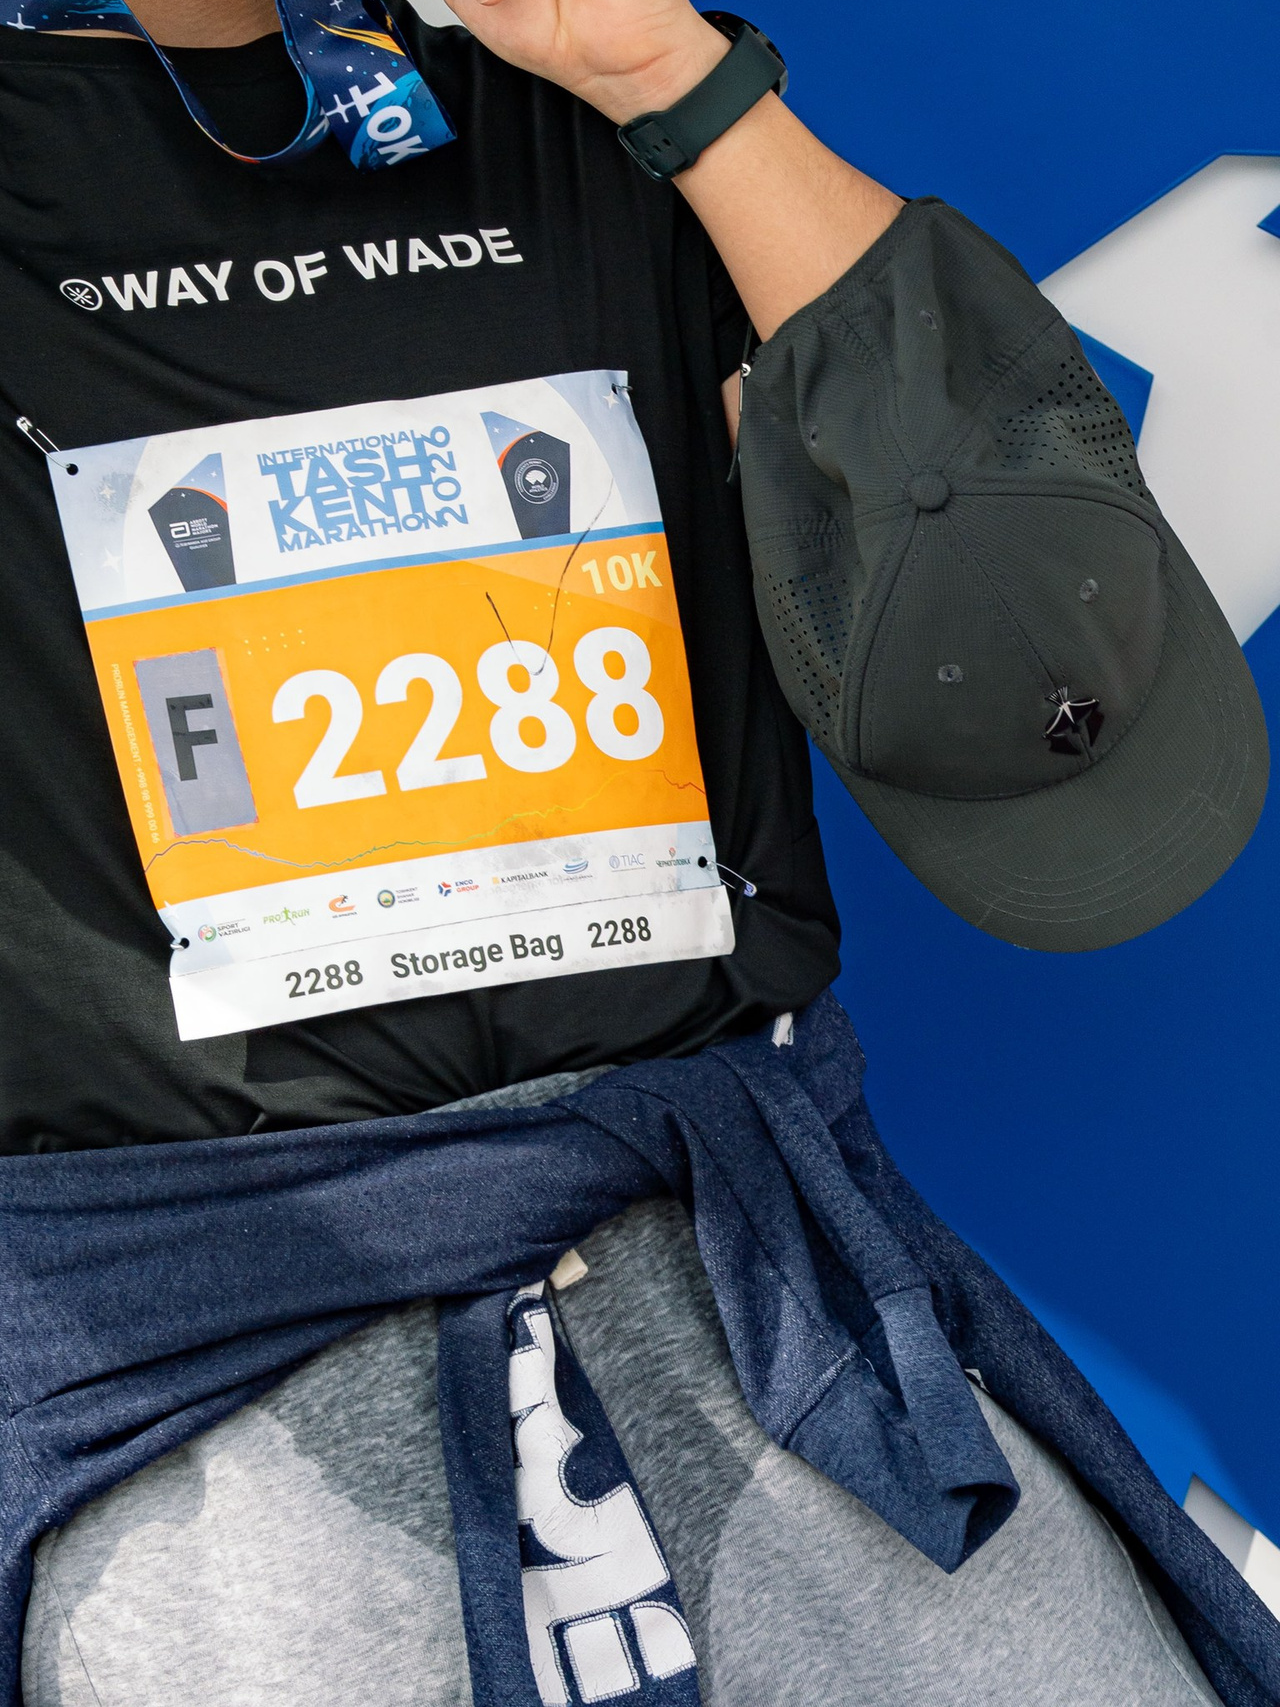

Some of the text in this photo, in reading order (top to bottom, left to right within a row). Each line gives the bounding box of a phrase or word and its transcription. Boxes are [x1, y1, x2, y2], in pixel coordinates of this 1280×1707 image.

[101, 227, 524, 312] WAY OF WADE
[256, 429, 422, 467] INTERNATIONAL
[260, 437, 433, 501] TASH
[268, 477, 433, 536] KENT
[276, 511, 444, 554] MARATHON
[581, 550, 663, 595] 10K
[164, 692, 219, 782] F
[271, 626, 665, 810] 2288
[500, 870, 549, 884] KAPITALBANK
[621, 853, 646, 867] TIAC
[455, 879, 474, 887] ENCO
[456, 884, 480, 893] GROUP
[217, 922, 239, 932] SPORT
[262, 908, 311, 925] PRO RUN
[284, 915, 653, 999] 2288 Storage Bag 2288
